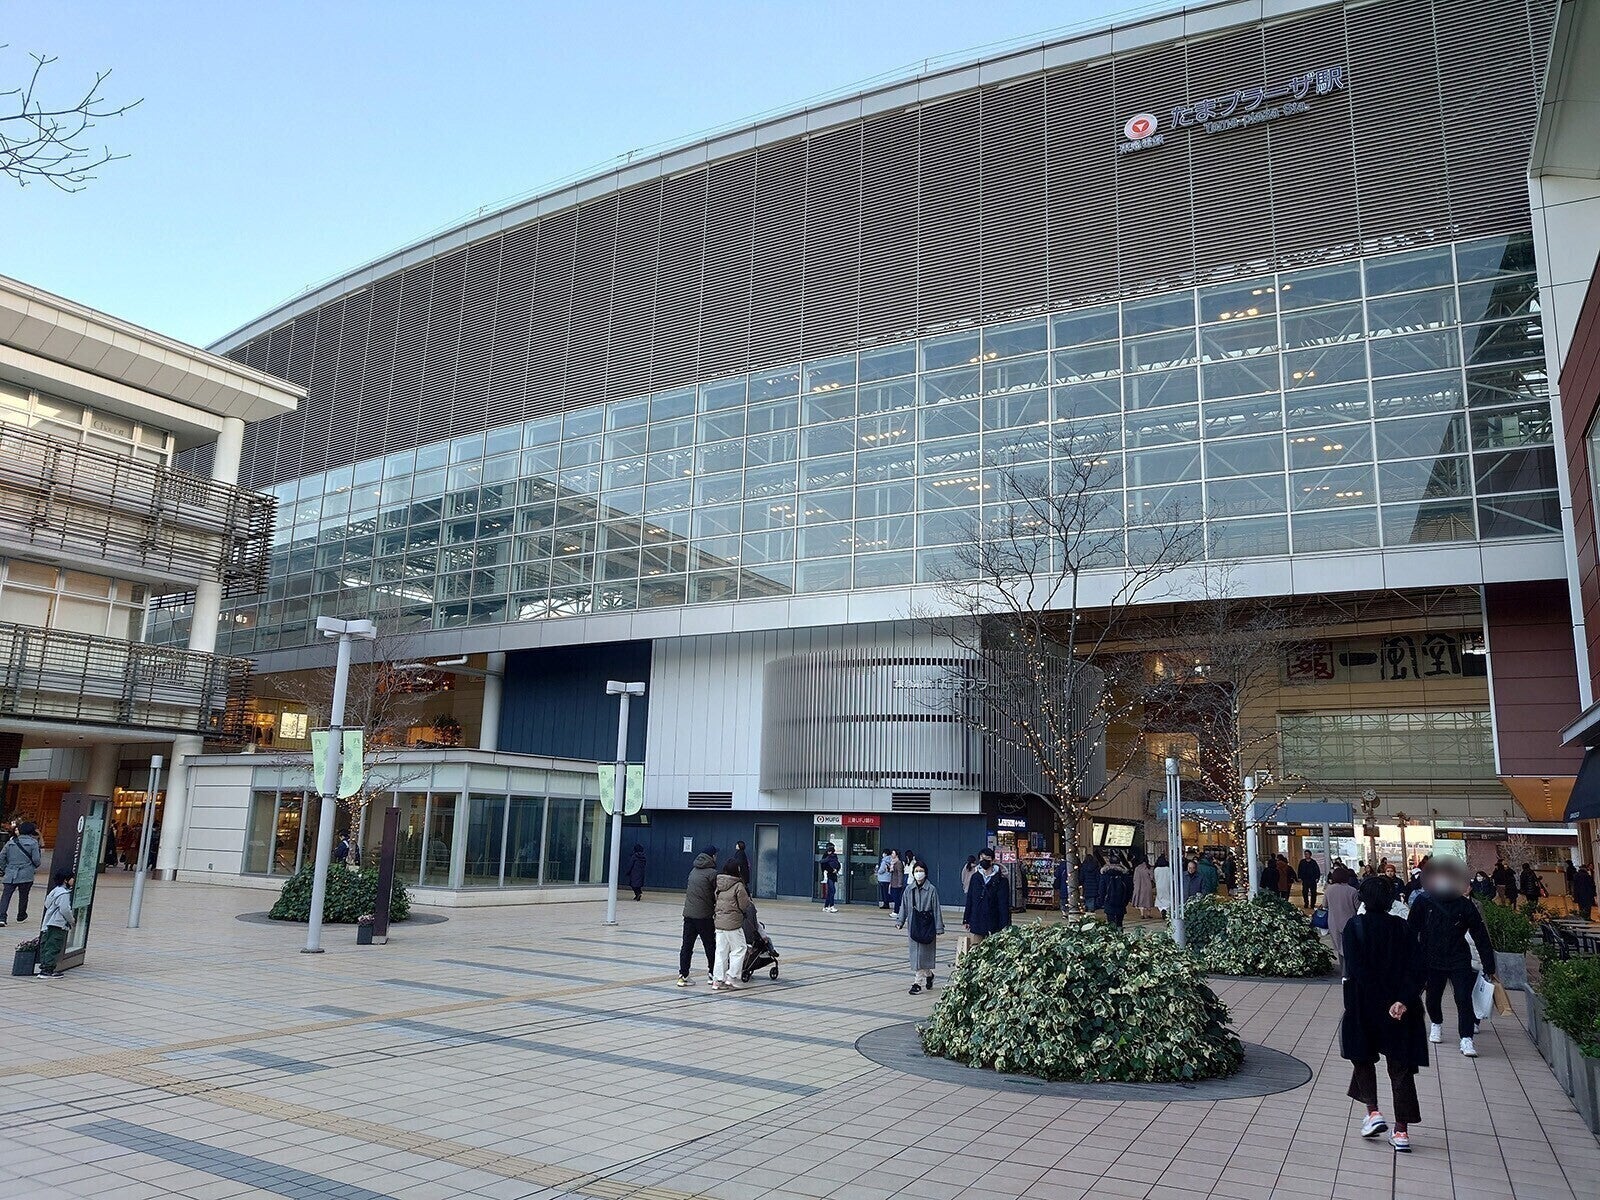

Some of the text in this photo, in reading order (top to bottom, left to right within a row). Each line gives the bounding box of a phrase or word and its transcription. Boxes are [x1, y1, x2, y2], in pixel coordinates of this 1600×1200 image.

[1171, 66, 1344, 128] たまプラーザ駅
